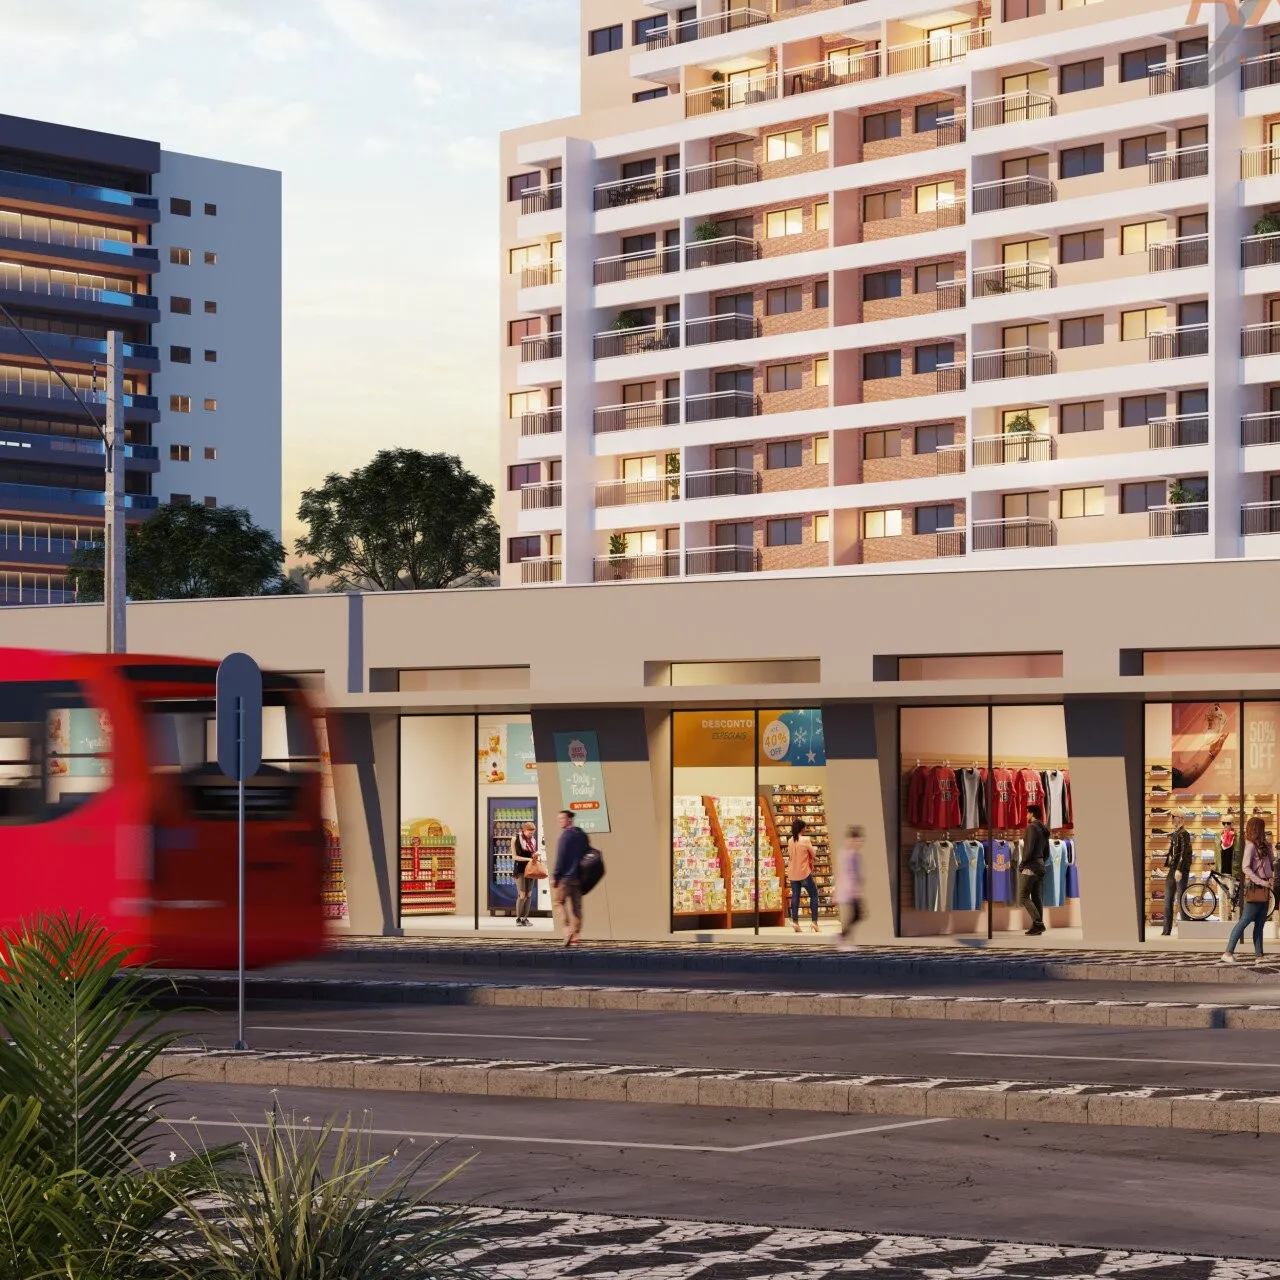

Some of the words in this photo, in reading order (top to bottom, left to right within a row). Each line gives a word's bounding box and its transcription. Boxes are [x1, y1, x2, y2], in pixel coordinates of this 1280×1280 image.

[764, 732, 787, 747] 40%
[1250, 721, 1276, 742] 50%
[770, 748, 782, 757] OFF
[1250, 743, 1276, 769] OFF
